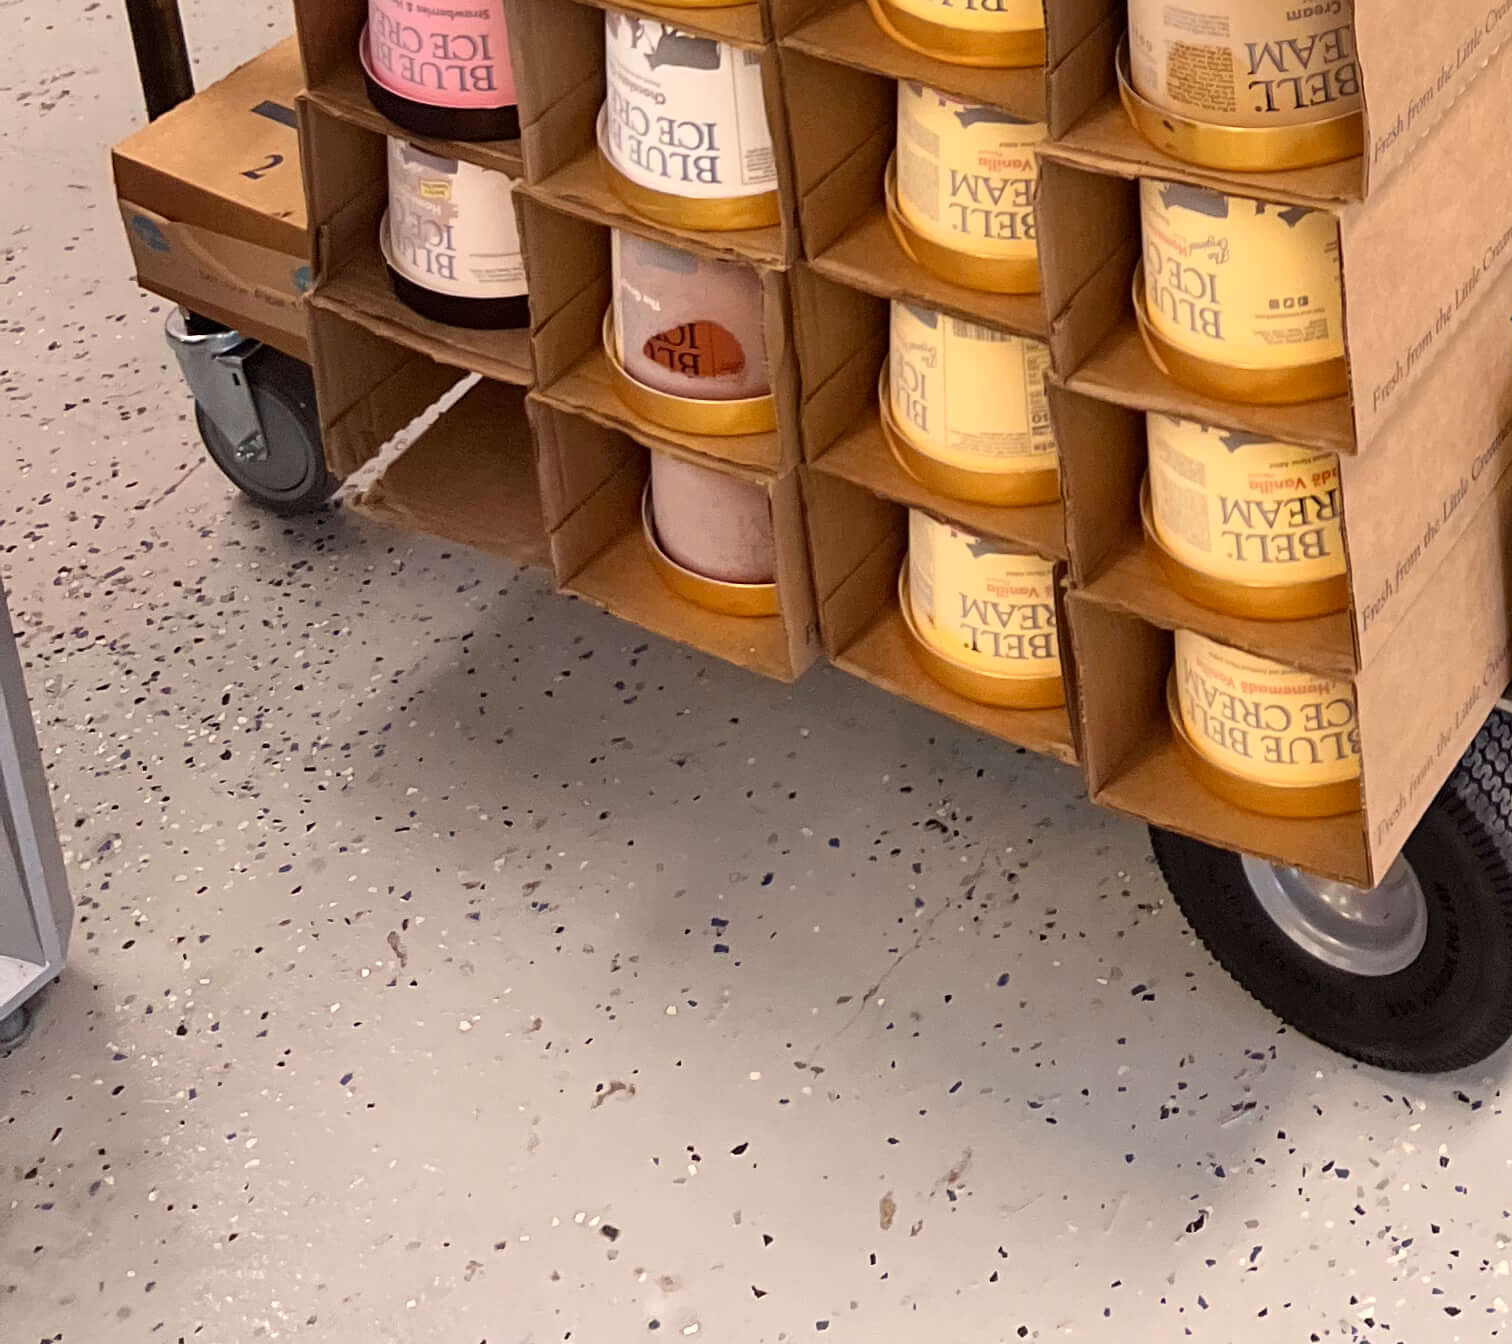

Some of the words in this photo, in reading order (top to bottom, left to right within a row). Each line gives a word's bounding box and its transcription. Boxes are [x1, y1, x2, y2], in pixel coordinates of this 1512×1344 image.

[1286, 0, 1341, 23] Cream
[430, 33, 494, 61] ICE
[400, 52, 498, 92] BLUE
[1248, 74, 1360, 113] BELL
[1406, 85, 1434, 130] from
[1436, 62, 1454, 92] the
[656, 116, 720, 152] ICE
[240, 152, 285, 179] 2
[628, 135, 724, 184] BLUE
[978, 156, 1034, 172] Vanilla
[949, 202, 1037, 241] BELL
[1166, 256, 1221, 305] ICE
[1406, 328, 1433, 376] from
[1435, 304, 1452, 336] the
[1248, 471, 1306, 492] Vanilla
[1221, 528, 1331, 563] BELL
[986, 582, 1040, 600] Vanilla
[1361, 577, 1393, 633] Fresh
[1395, 543, 1422, 594] from
[1423, 519, 1441, 549] the
[961, 625, 1053, 661] BELL
